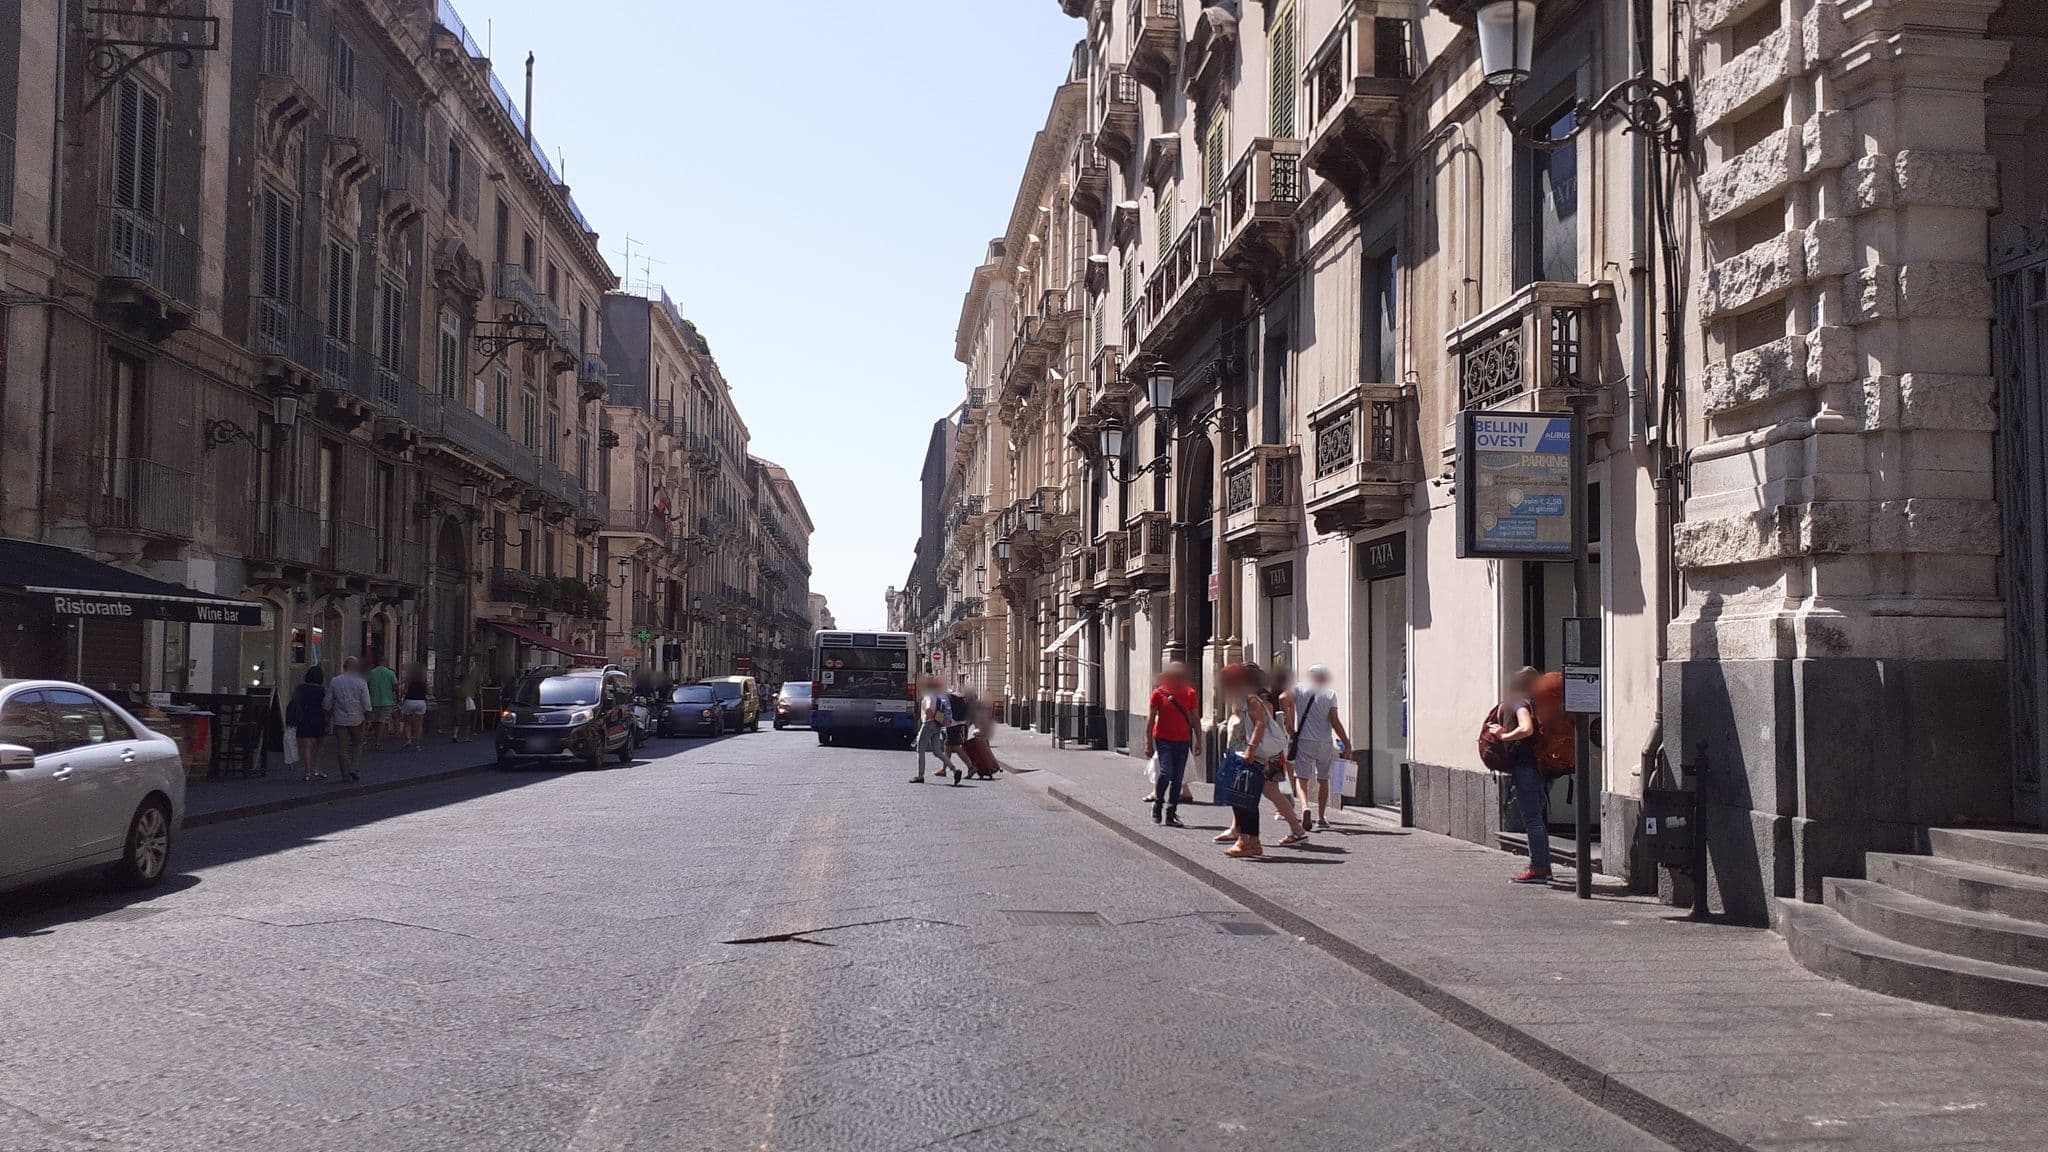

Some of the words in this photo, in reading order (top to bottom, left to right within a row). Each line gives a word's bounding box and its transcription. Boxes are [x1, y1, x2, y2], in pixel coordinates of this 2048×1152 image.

[1475, 420, 1528, 434] BELLINI
[1478, 434, 1525, 447] OVEST
[1521, 455, 1568, 468] PARKING
[1369, 543, 1394, 566] TATA
[1269, 568, 1286, 584] TATA
[54, 597, 133, 616] Ristorante
[197, 606, 222, 620] Wine
[224, 608, 240, 622] bar
